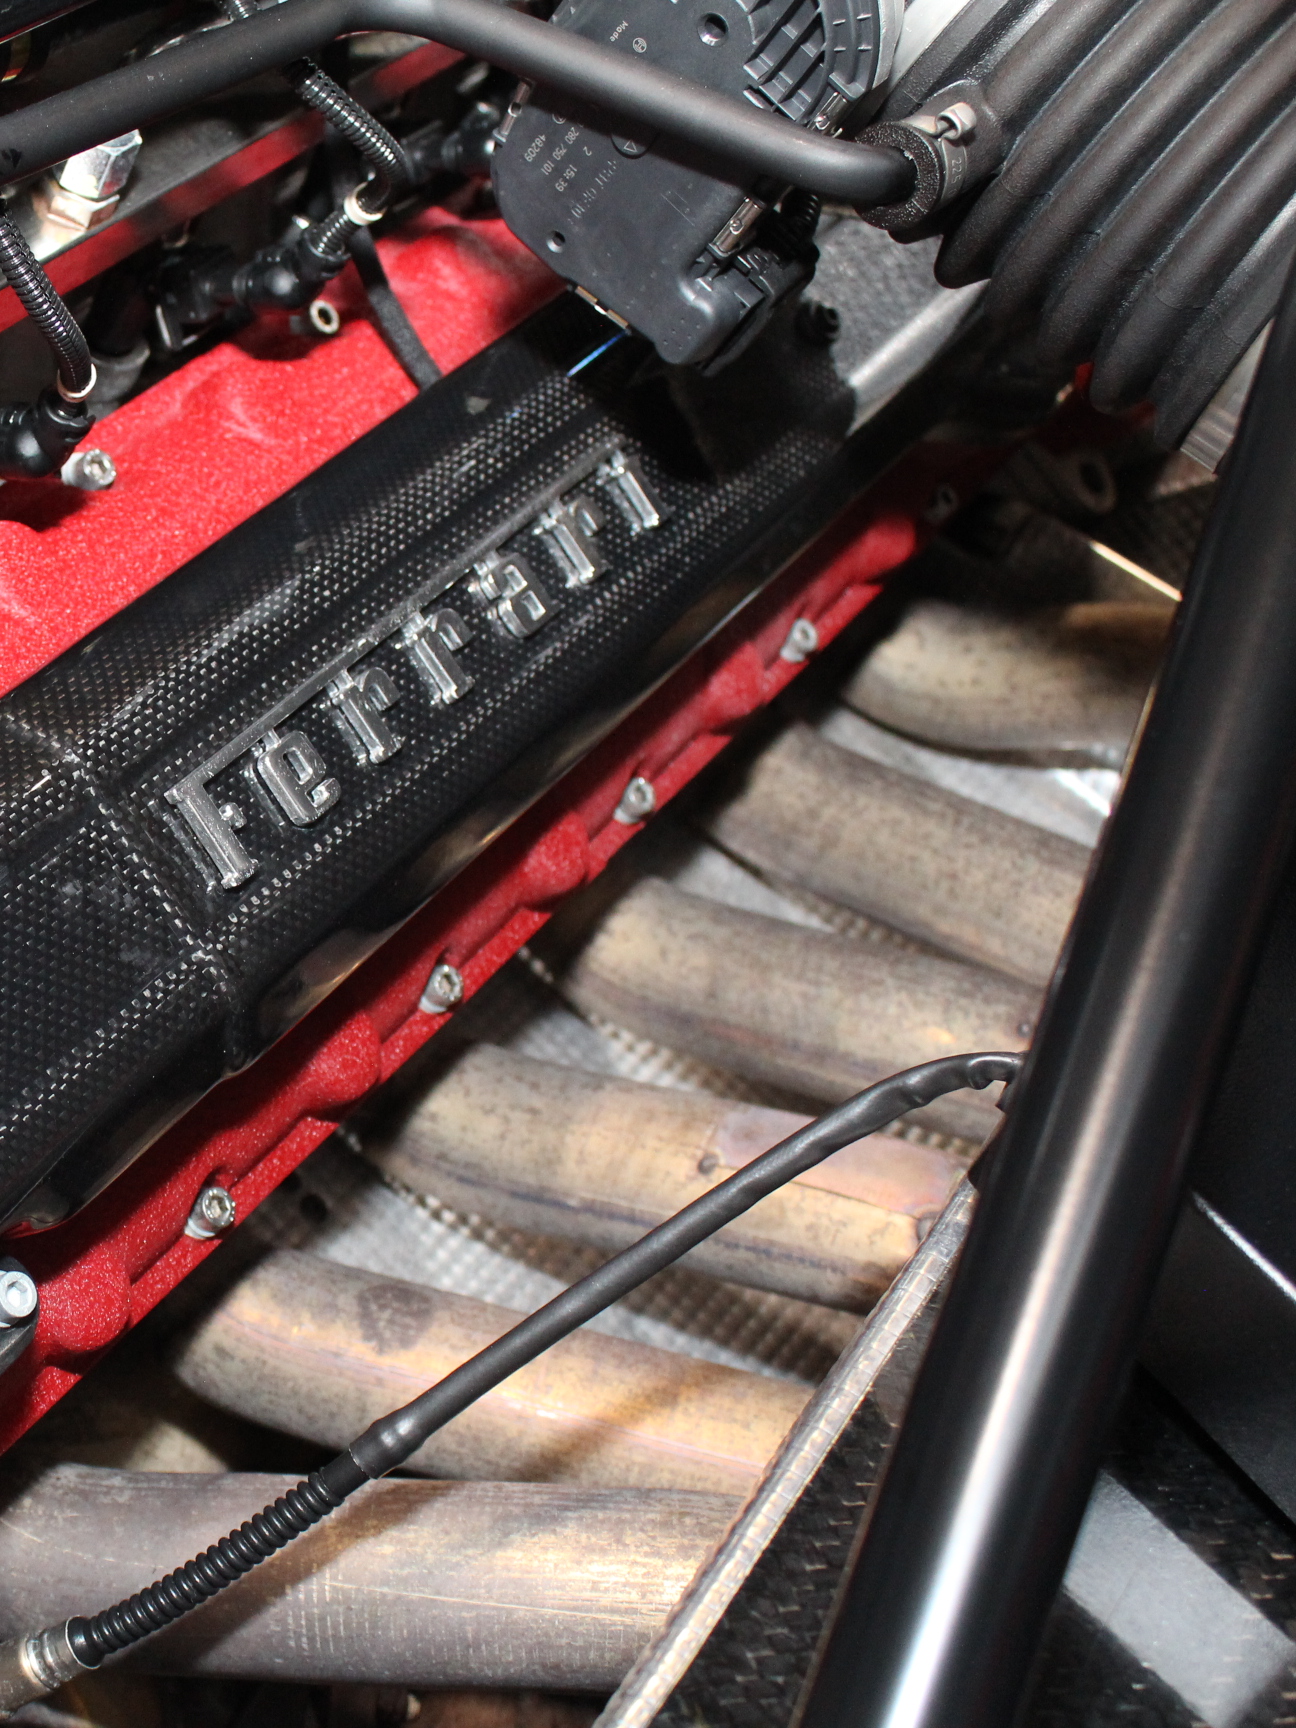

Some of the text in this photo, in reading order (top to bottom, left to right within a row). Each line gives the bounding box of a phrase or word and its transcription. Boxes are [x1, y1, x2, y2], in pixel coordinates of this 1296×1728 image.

[609, 20, 629, 42] Made
[524, 134, 546, 162] 48209
[540, 127, 580, 176] 280 750 101
[582, 146, 593, 157] 2
[951, 156, 962, 184] 225
[163, 436, 664, 890] Ferrari
